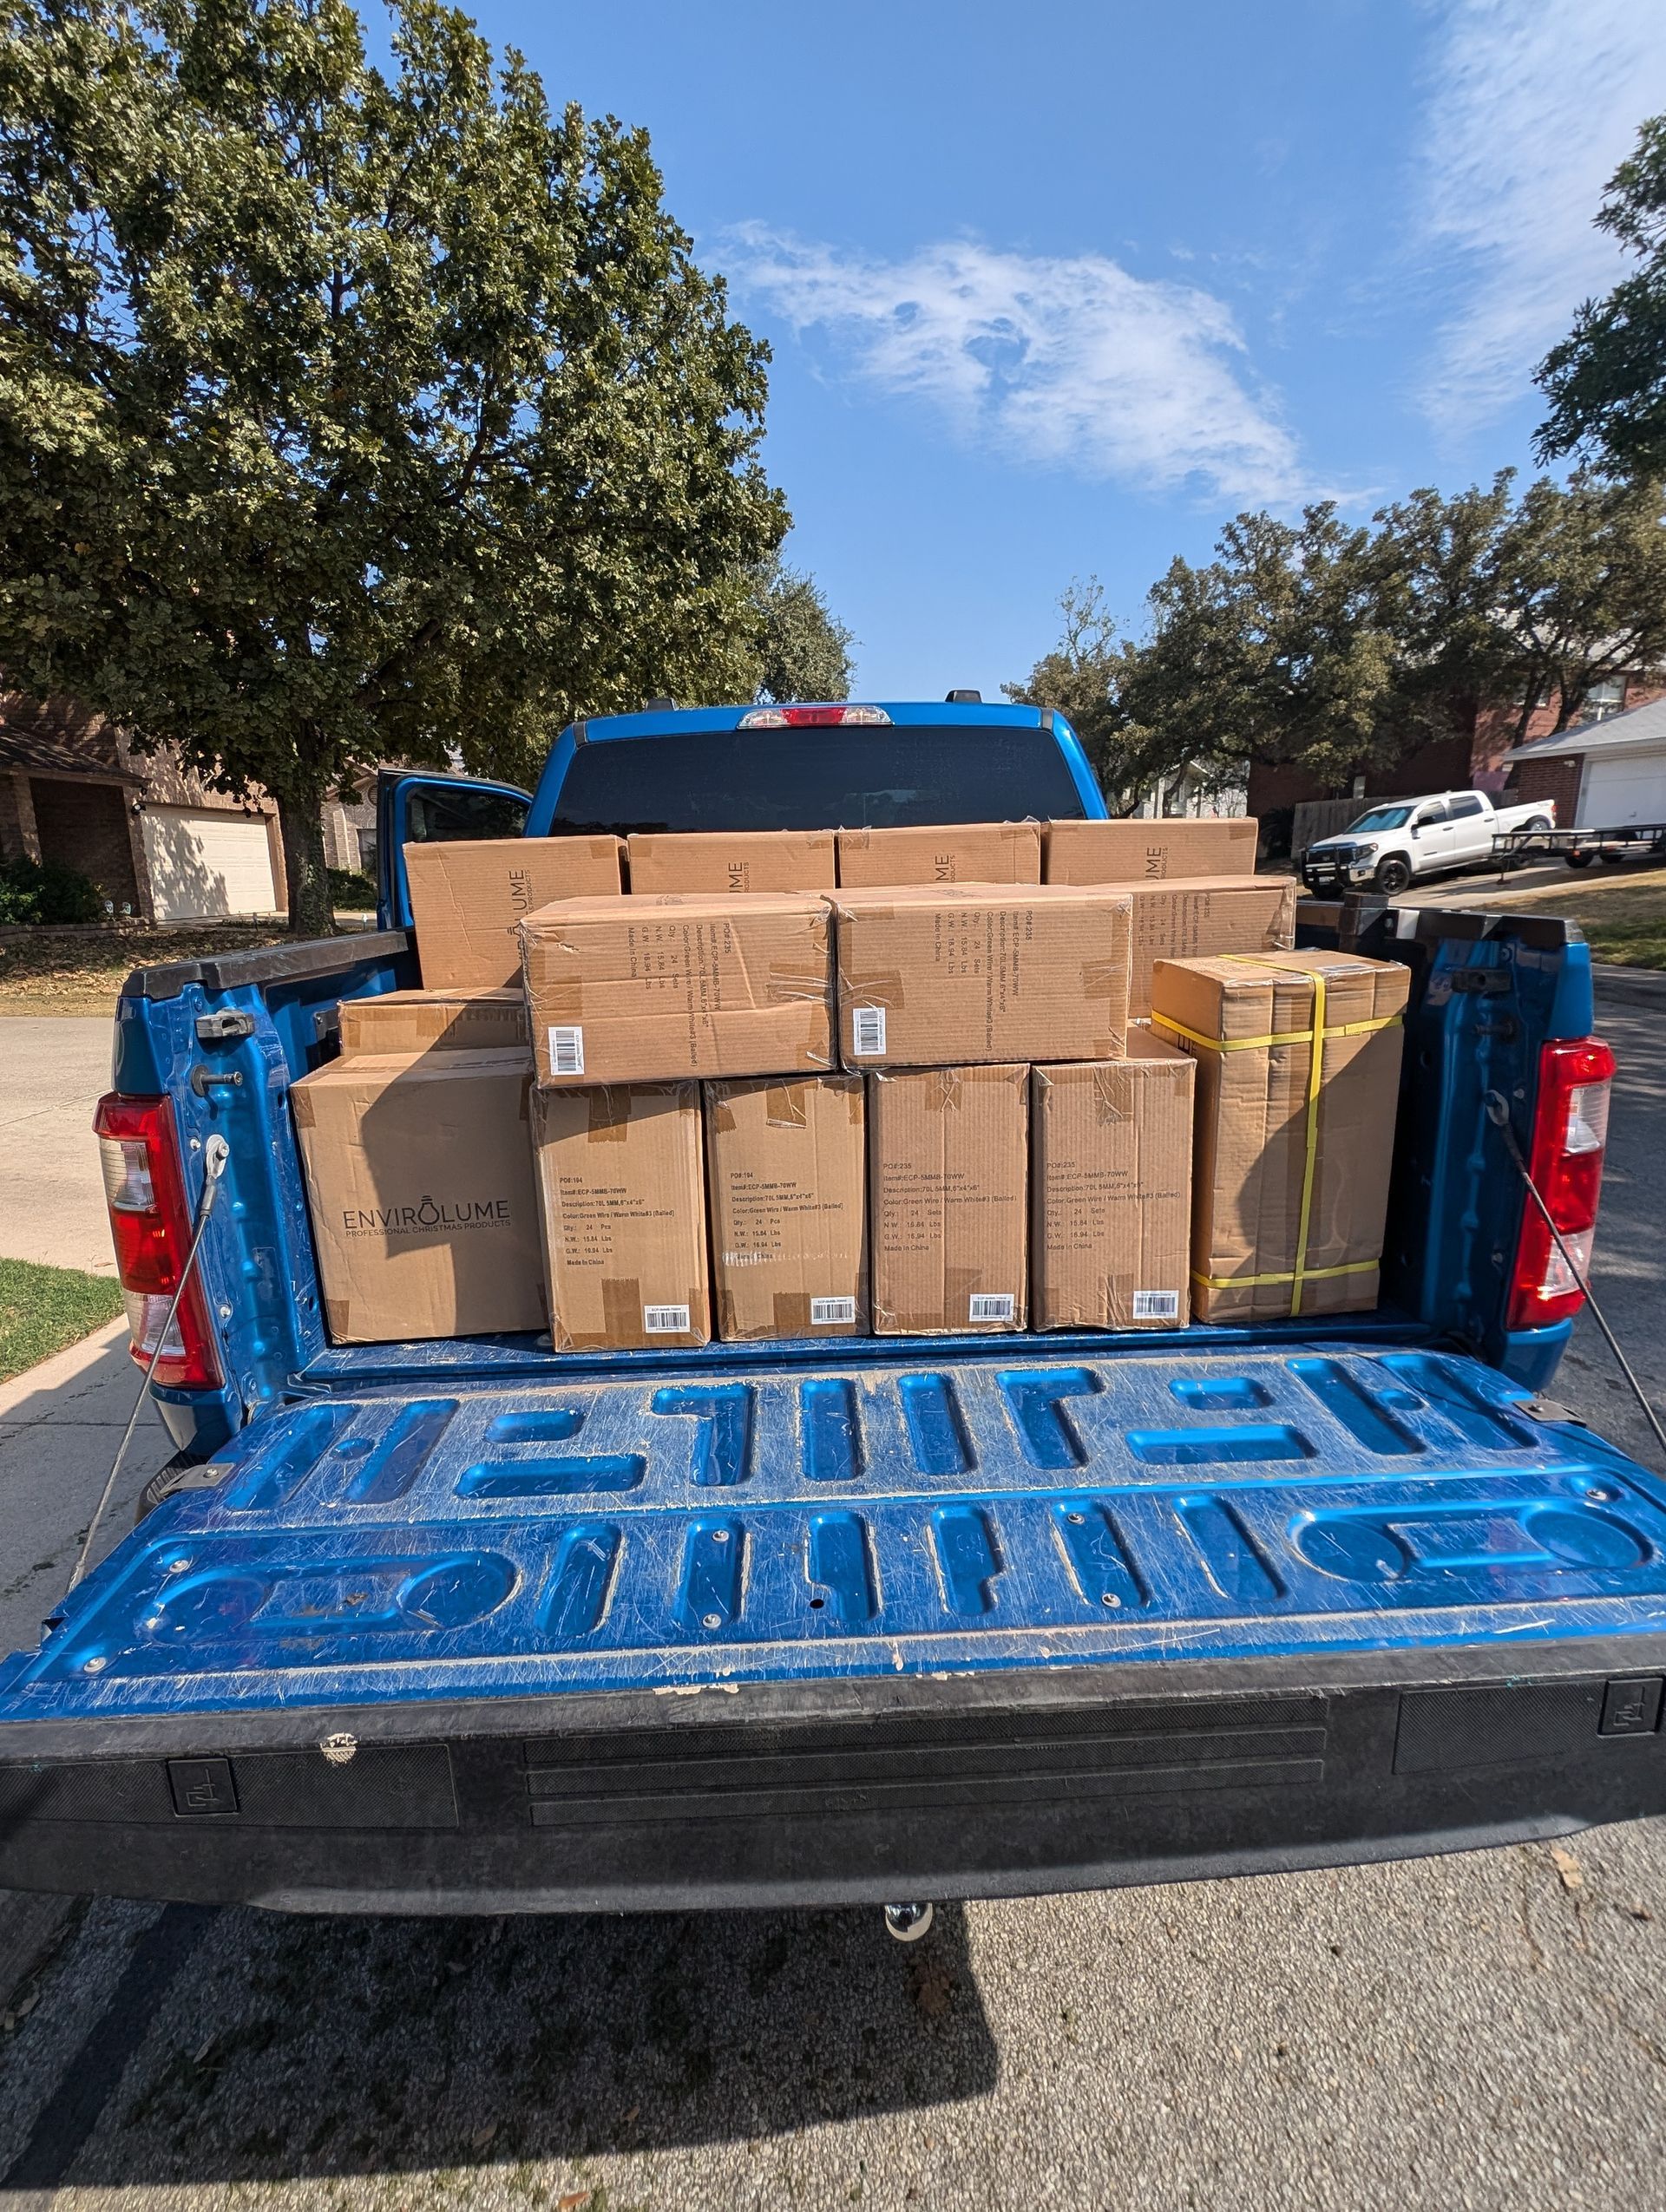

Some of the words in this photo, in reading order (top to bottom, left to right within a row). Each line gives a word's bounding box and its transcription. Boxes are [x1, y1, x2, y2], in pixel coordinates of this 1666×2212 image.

[524, 869, 535, 904] PRODUCTS
[728, 862, 743, 893] ME
[672, 955, 677, 964] 24
[343, 1195, 510, 1229] ENVIROLUME
[345, 1227, 411, 1238] PROFESSIONAL
[412, 1223, 463, 1233] CHRISTMAS
[464, 1220, 511, 1229] PRODUCTS
